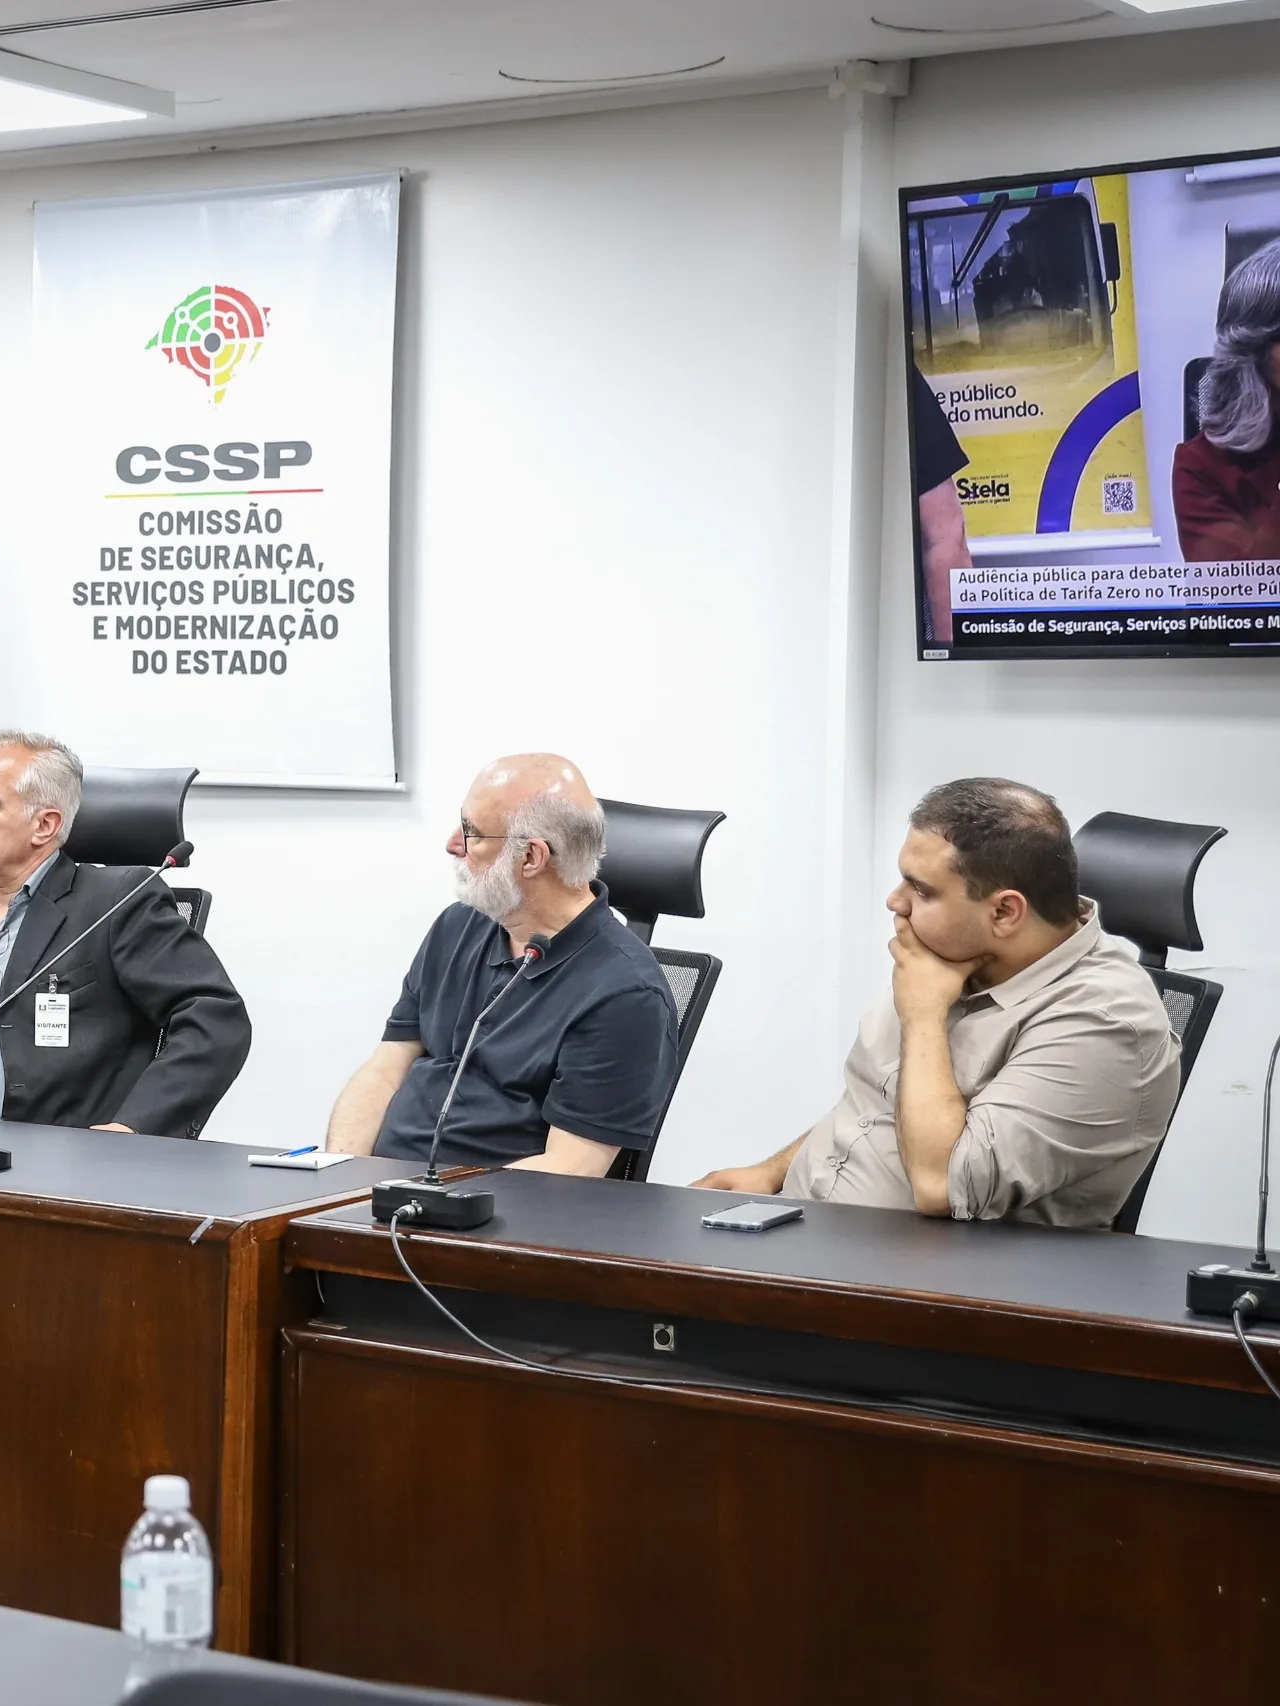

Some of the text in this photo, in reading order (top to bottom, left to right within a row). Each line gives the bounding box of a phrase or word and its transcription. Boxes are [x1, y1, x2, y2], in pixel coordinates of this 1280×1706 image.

[950, 383, 1017, 407] público
[948, 401, 1044, 423] do mundo.
[116, 440, 313, 484] CSSP
[956, 478, 1010, 499] Stela
[138, 502, 282, 536] COMISSÃO
[100, 543, 324, 575] DE SEGURANÇA,
[958, 569, 1028, 584] Audiência
[1033, 568, 1086, 585] pública
[1091, 568, 1124, 583] para
[1129, 565, 1189, 580] debater
[1194, 568, 1202, 578] a
[72, 573, 355, 611] SERVIÇOS PÚBLICOS
[959, 580, 1280, 602] da Política de Tarifa Zero no Transporte Pú
[93, 608, 339, 646] E MODERNIZAÇÃO
[961, 618, 1025, 634] Comissão
[1028, 619, 1045, 633] de
[1048, 619, 1123, 635] Segurança,
[1126, 616, 1186, 634] Serviços
[1189, 614, 1252, 630] Públicos
[1255, 617, 1264, 629] e
[132, 649, 287, 675] DO ESTADO
